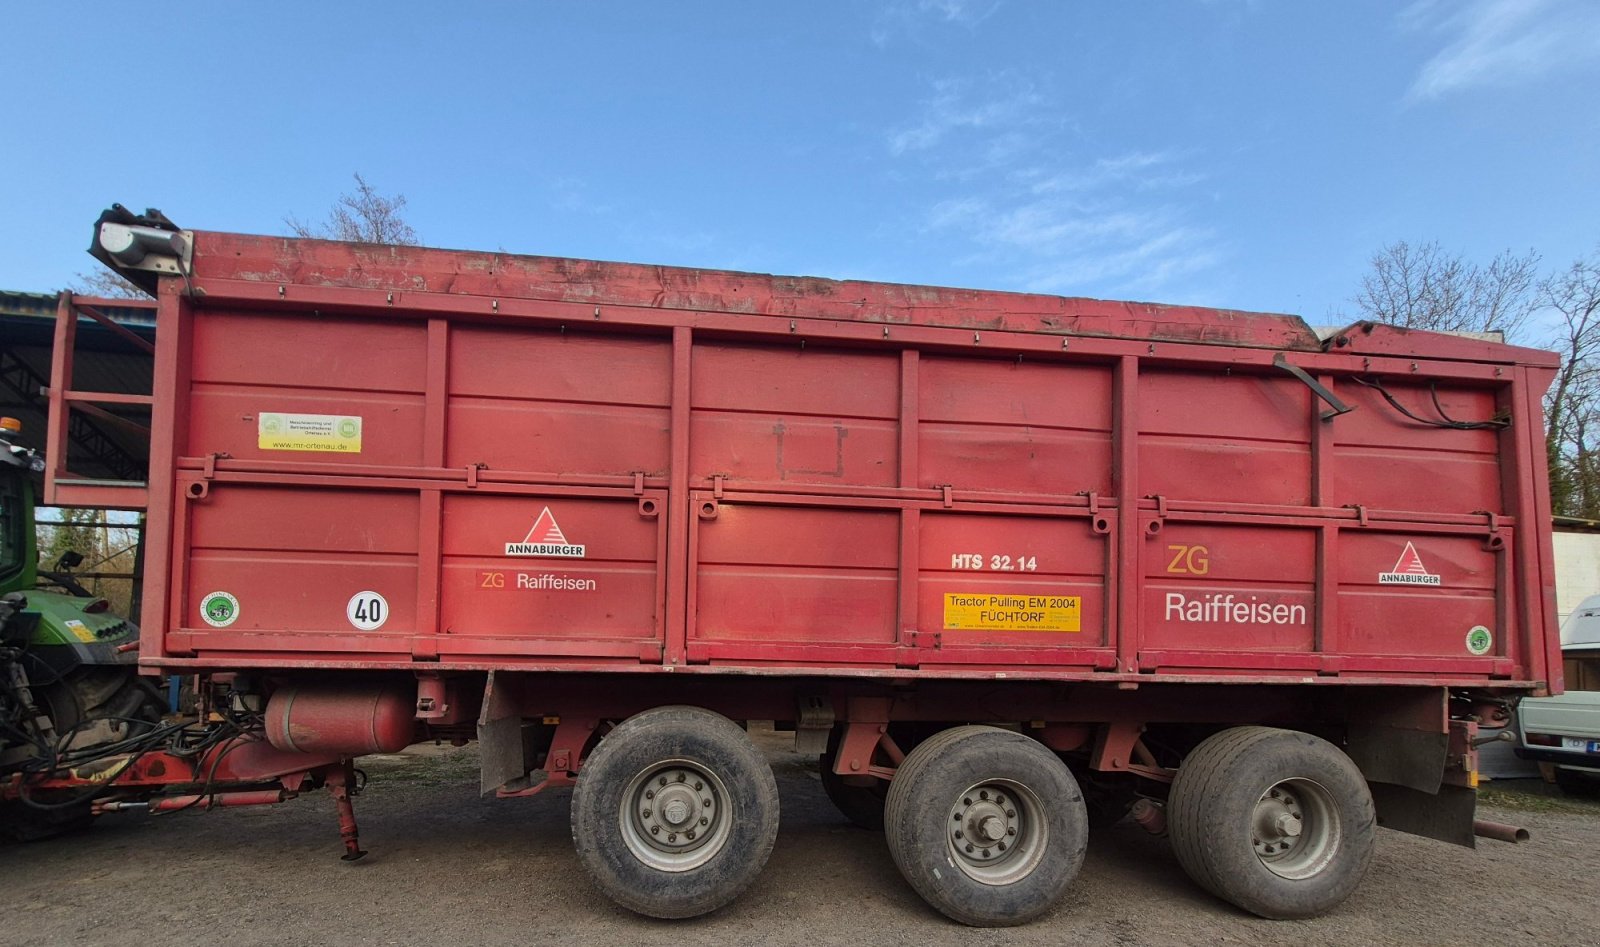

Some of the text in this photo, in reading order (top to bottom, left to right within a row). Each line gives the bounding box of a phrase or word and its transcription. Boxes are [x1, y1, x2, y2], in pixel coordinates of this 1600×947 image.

[273, 442, 347, 450] www.mr-ortenau.de
[507, 544, 583, 556] ANNABURGER
[951, 554, 1038, 571] HTS 32.14
[1167, 545, 1209, 575] ZG
[481, 572, 596, 591] ZG Raiffeisen
[1380, 574, 1439, 584] ANNABURGER
[355, 599, 381, 622] 40
[949, 595, 1076, 610] Tractor Pulling EM 2004
[1165, 593, 1306, 625] Raiffeisen
[980, 609, 1046, 622] FÜCHTORF
